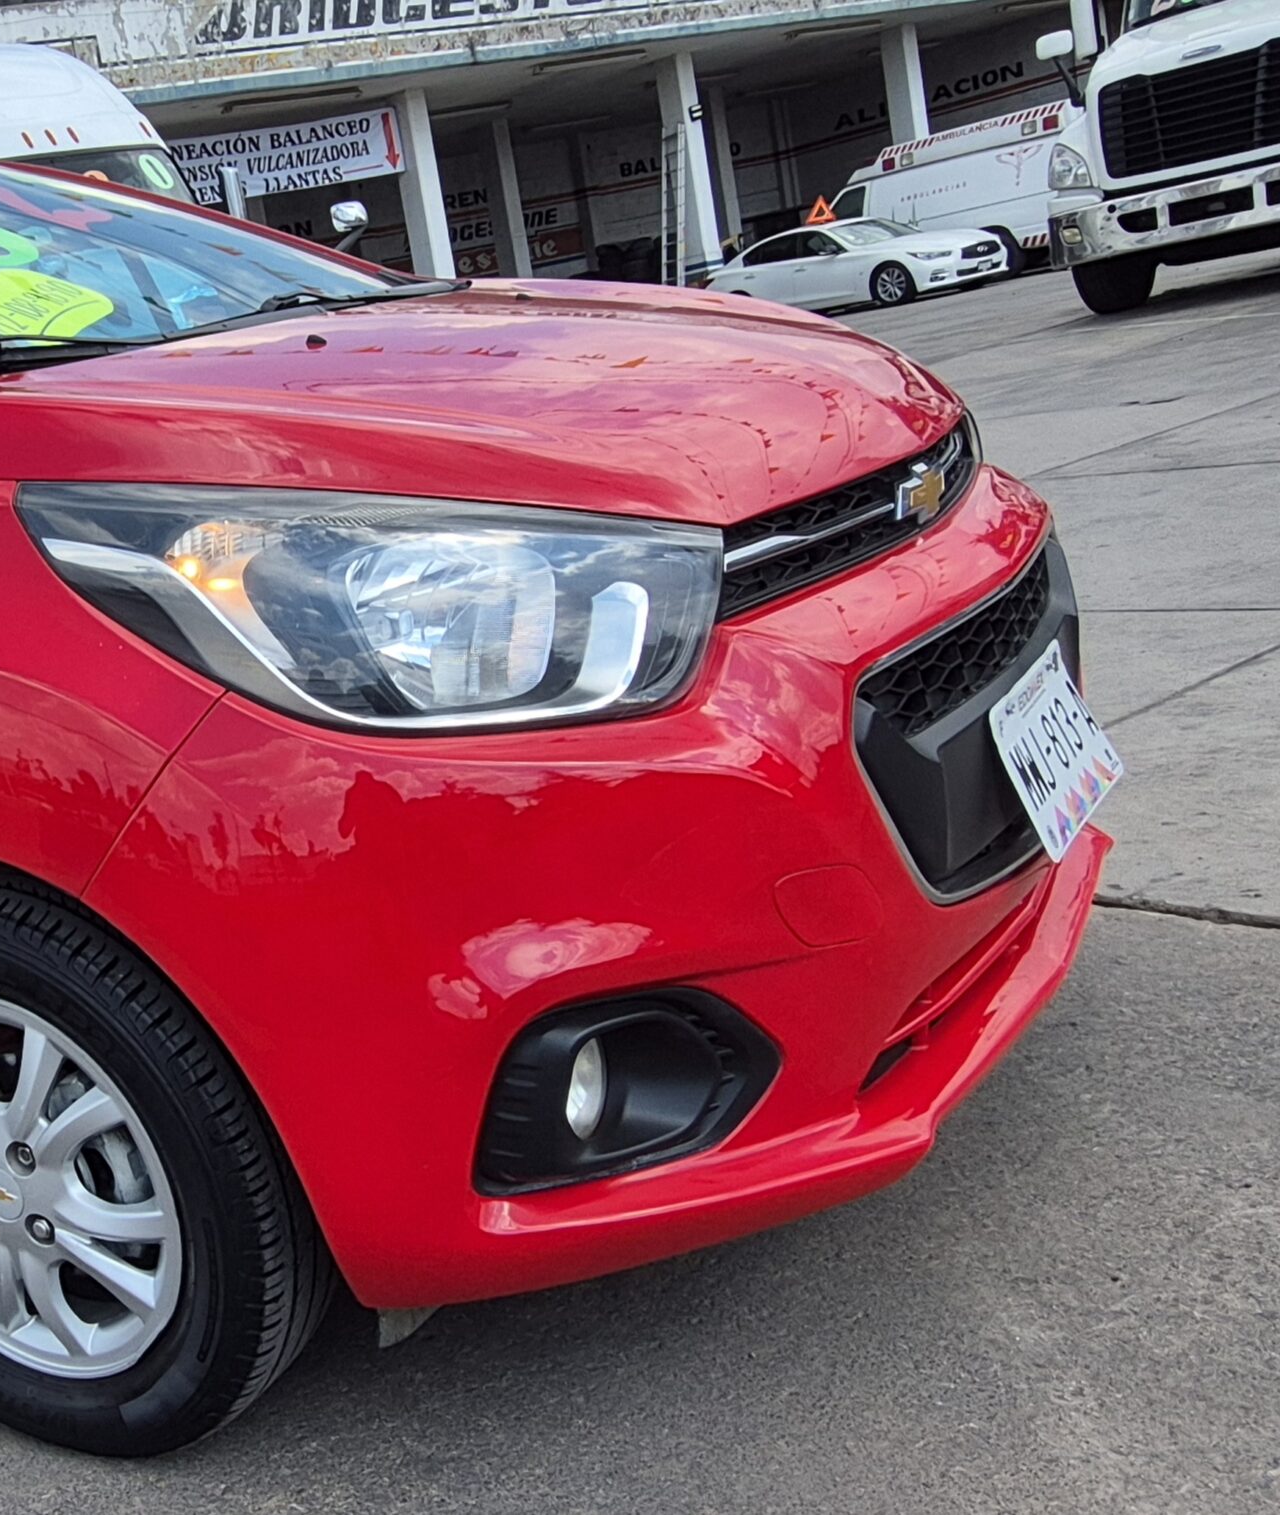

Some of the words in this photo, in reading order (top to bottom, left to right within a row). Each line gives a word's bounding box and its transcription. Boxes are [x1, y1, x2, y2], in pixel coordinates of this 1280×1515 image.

[270, 117, 370, 150] BALANCEO
[934, 118, 1001, 143] AMBULANCIA
[247, 139, 371, 175] VULCANIZADORA
[264, 166, 344, 193] LLANTAS
